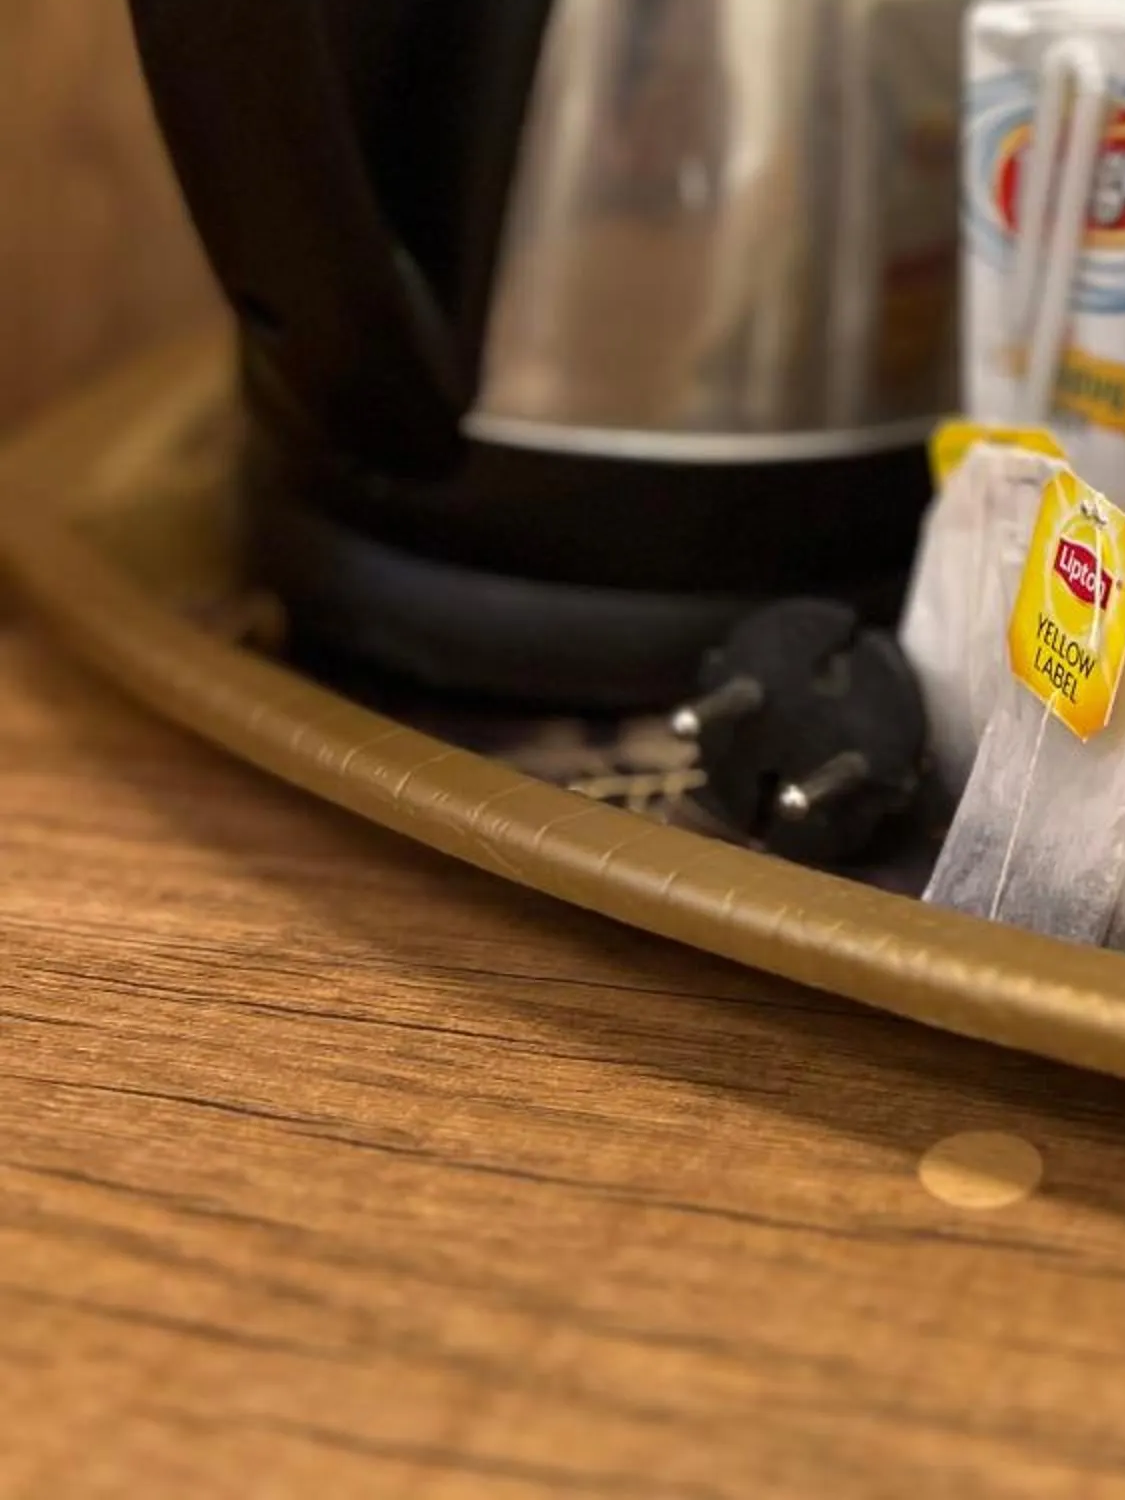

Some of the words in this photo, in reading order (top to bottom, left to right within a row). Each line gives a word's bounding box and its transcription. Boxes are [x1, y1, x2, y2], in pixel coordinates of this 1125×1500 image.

[1058, 545, 1107, 598] Lipton
[1035, 612, 1096, 680] YELLOW
[1033, 647, 1079, 704] LABEL
